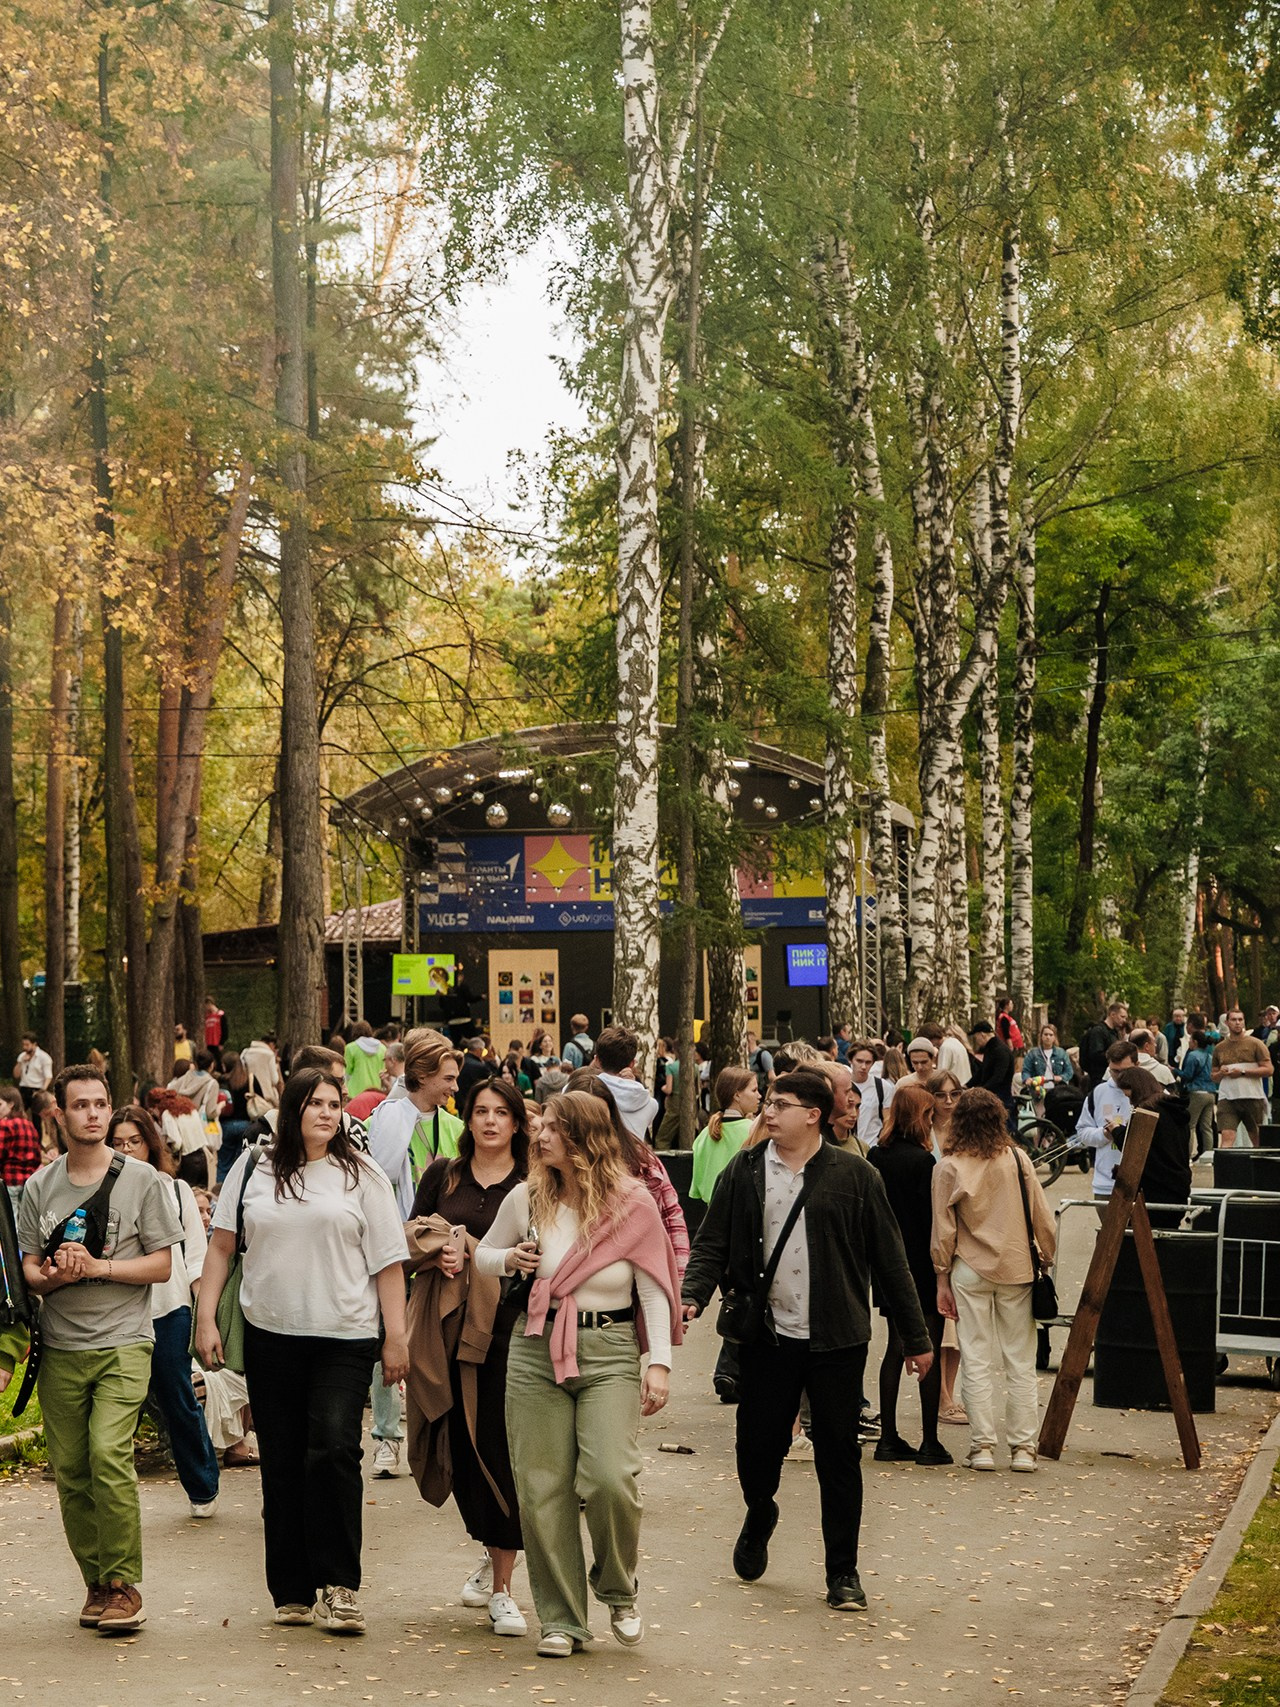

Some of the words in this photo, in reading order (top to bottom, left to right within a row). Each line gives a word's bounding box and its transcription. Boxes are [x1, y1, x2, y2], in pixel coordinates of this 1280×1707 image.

[427, 913, 456, 928] УЦСБ
[486, 915, 534, 925] NAUMEN
[791, 949, 814, 958] ПИК
[792, 958, 815, 967] НИК
